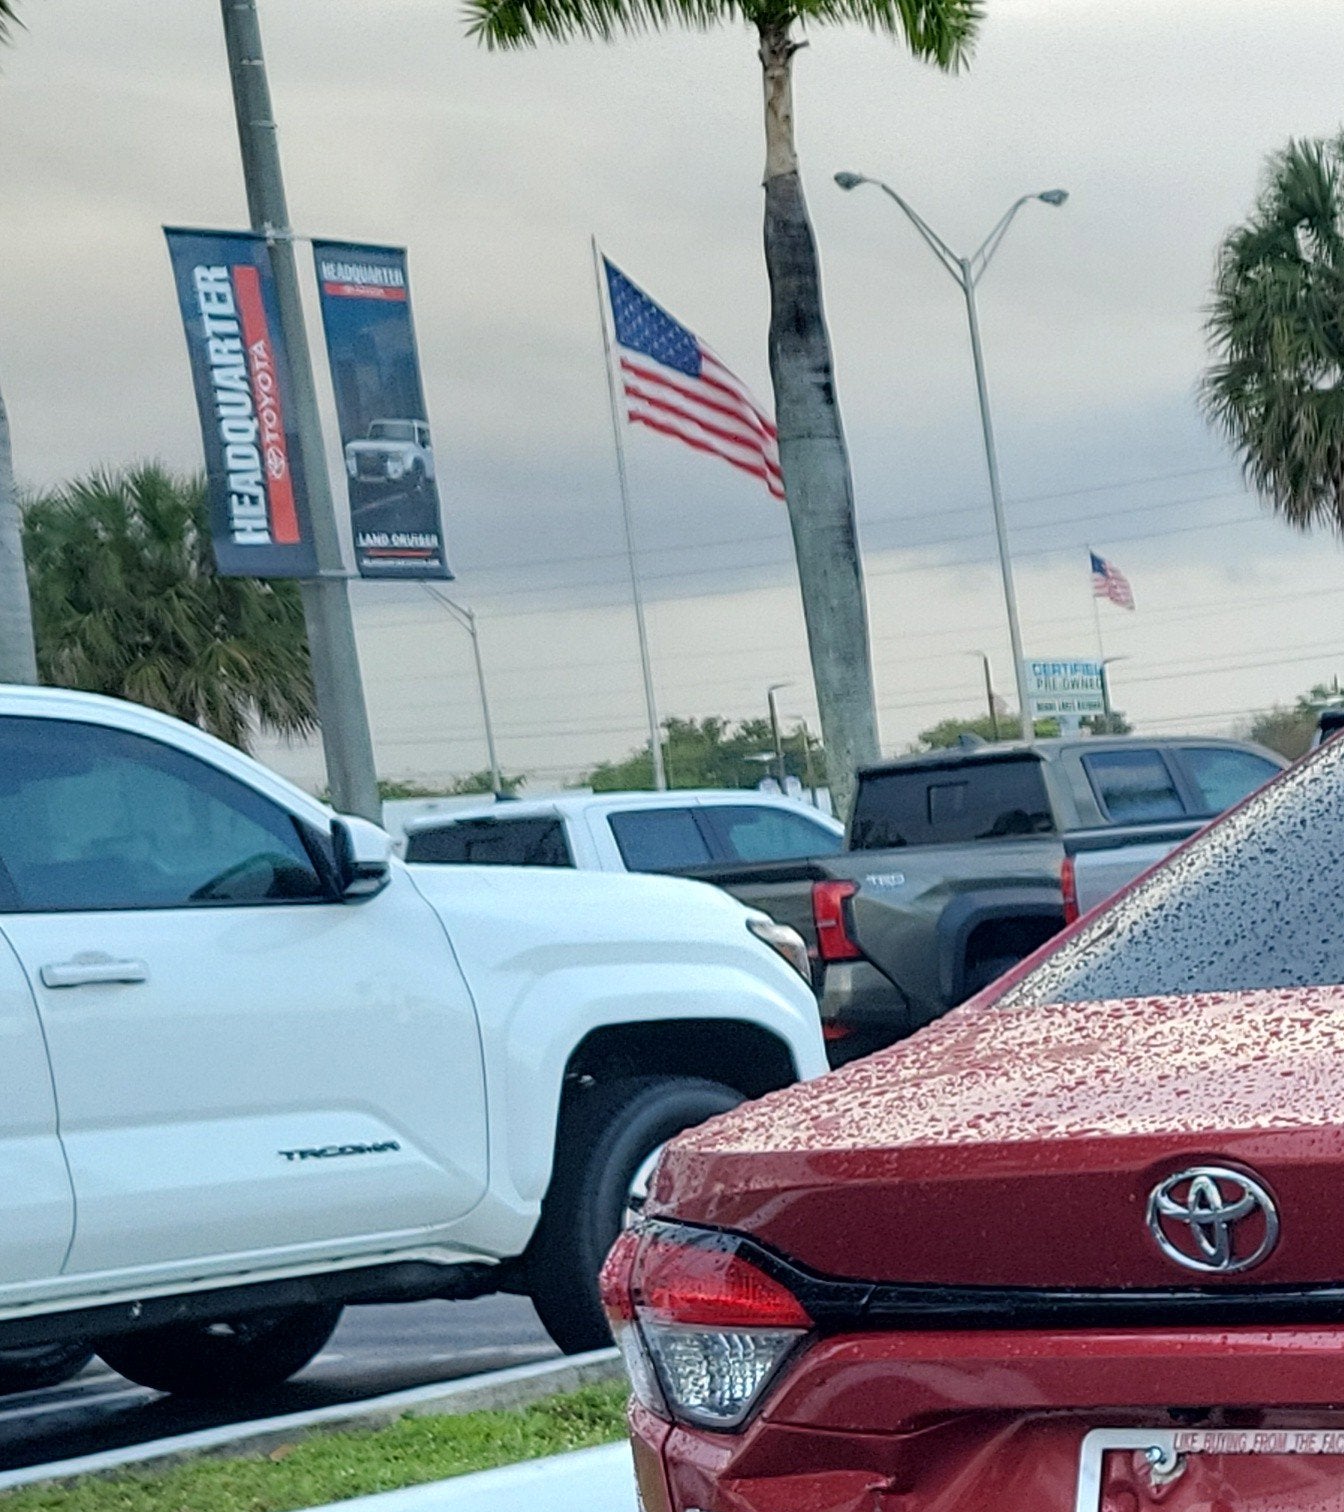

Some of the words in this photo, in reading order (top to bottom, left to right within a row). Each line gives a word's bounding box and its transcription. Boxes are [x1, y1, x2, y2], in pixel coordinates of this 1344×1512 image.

[322, 261, 404, 286] HEADQUARTER
[248, 339, 286, 445] TOYOTA
[193, 264, 272, 546] HEADQUARTER
[357, 532, 389, 547] LAND
[391, 533, 438, 547] CRUISER
[865, 873, 906, 886] TRD
[278, 1140, 401, 1161] TACOMA
[1173, 1432, 1198, 1451] LIKE
[1203, 1432, 1248, 1452] BUYING
[1252, 1433, 1288, 1453] FROM
[1294, 1434, 1317, 1454] THE
